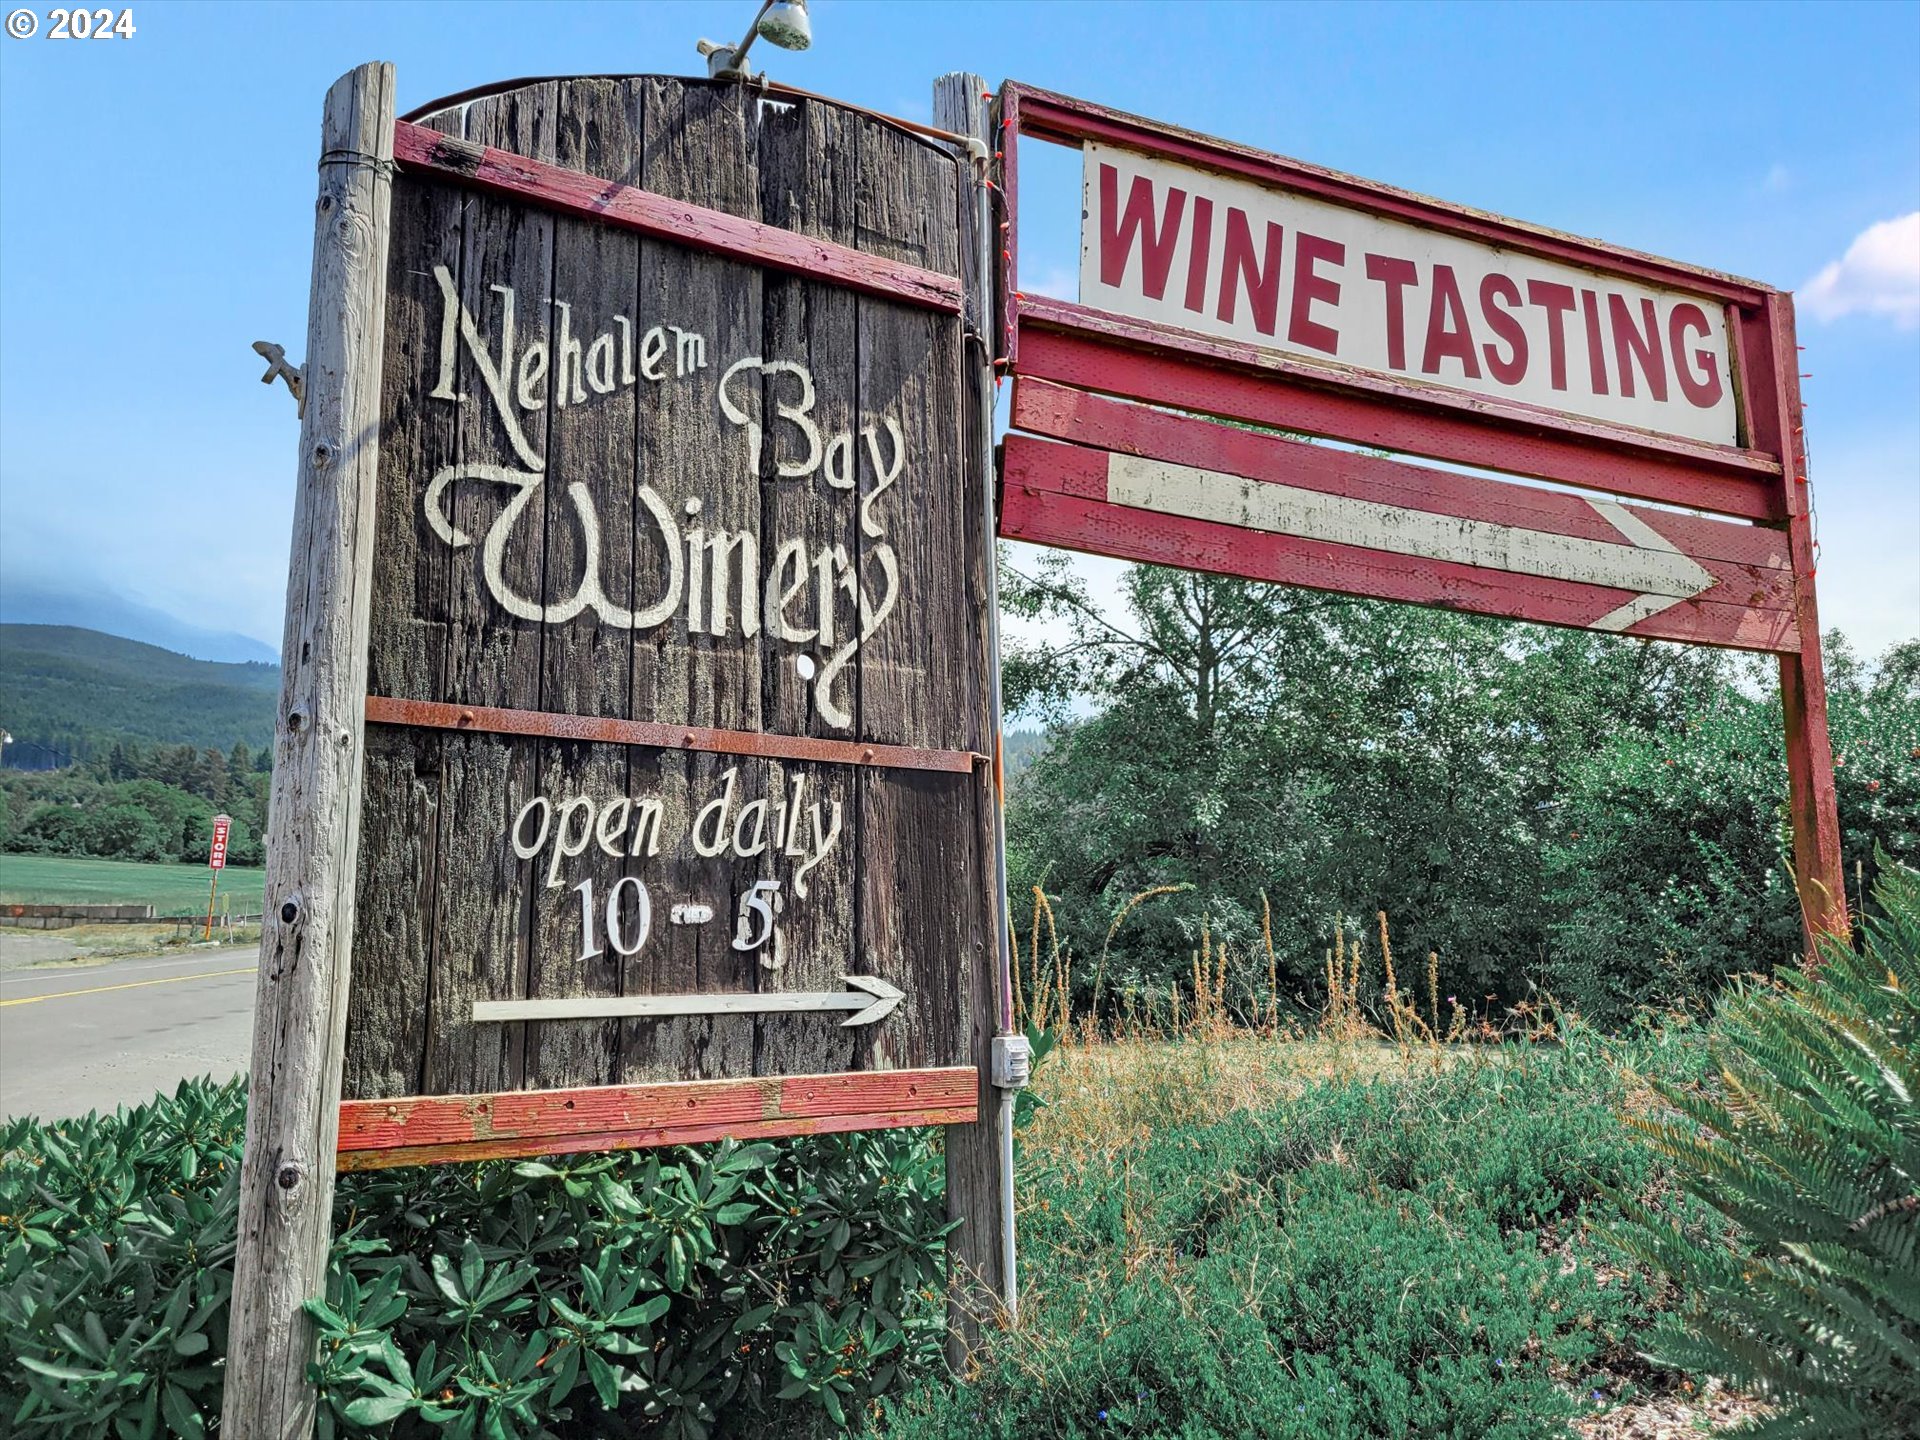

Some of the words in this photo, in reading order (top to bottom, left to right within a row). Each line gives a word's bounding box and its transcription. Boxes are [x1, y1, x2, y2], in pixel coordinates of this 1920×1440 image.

[1099, 162, 1345, 355] WINE
[1365, 253, 1724, 408] TASTING
[430, 266, 707, 472] Nehalem
[719, 357, 902, 537] Bay
[424, 464, 899, 729] Winery
[212, 827, 226, 867] STORE
[512, 796, 664, 888] open
[693, 767, 842, 898] daily
[573, 877, 651, 962] 10
[732, 880, 782, 952] 5
